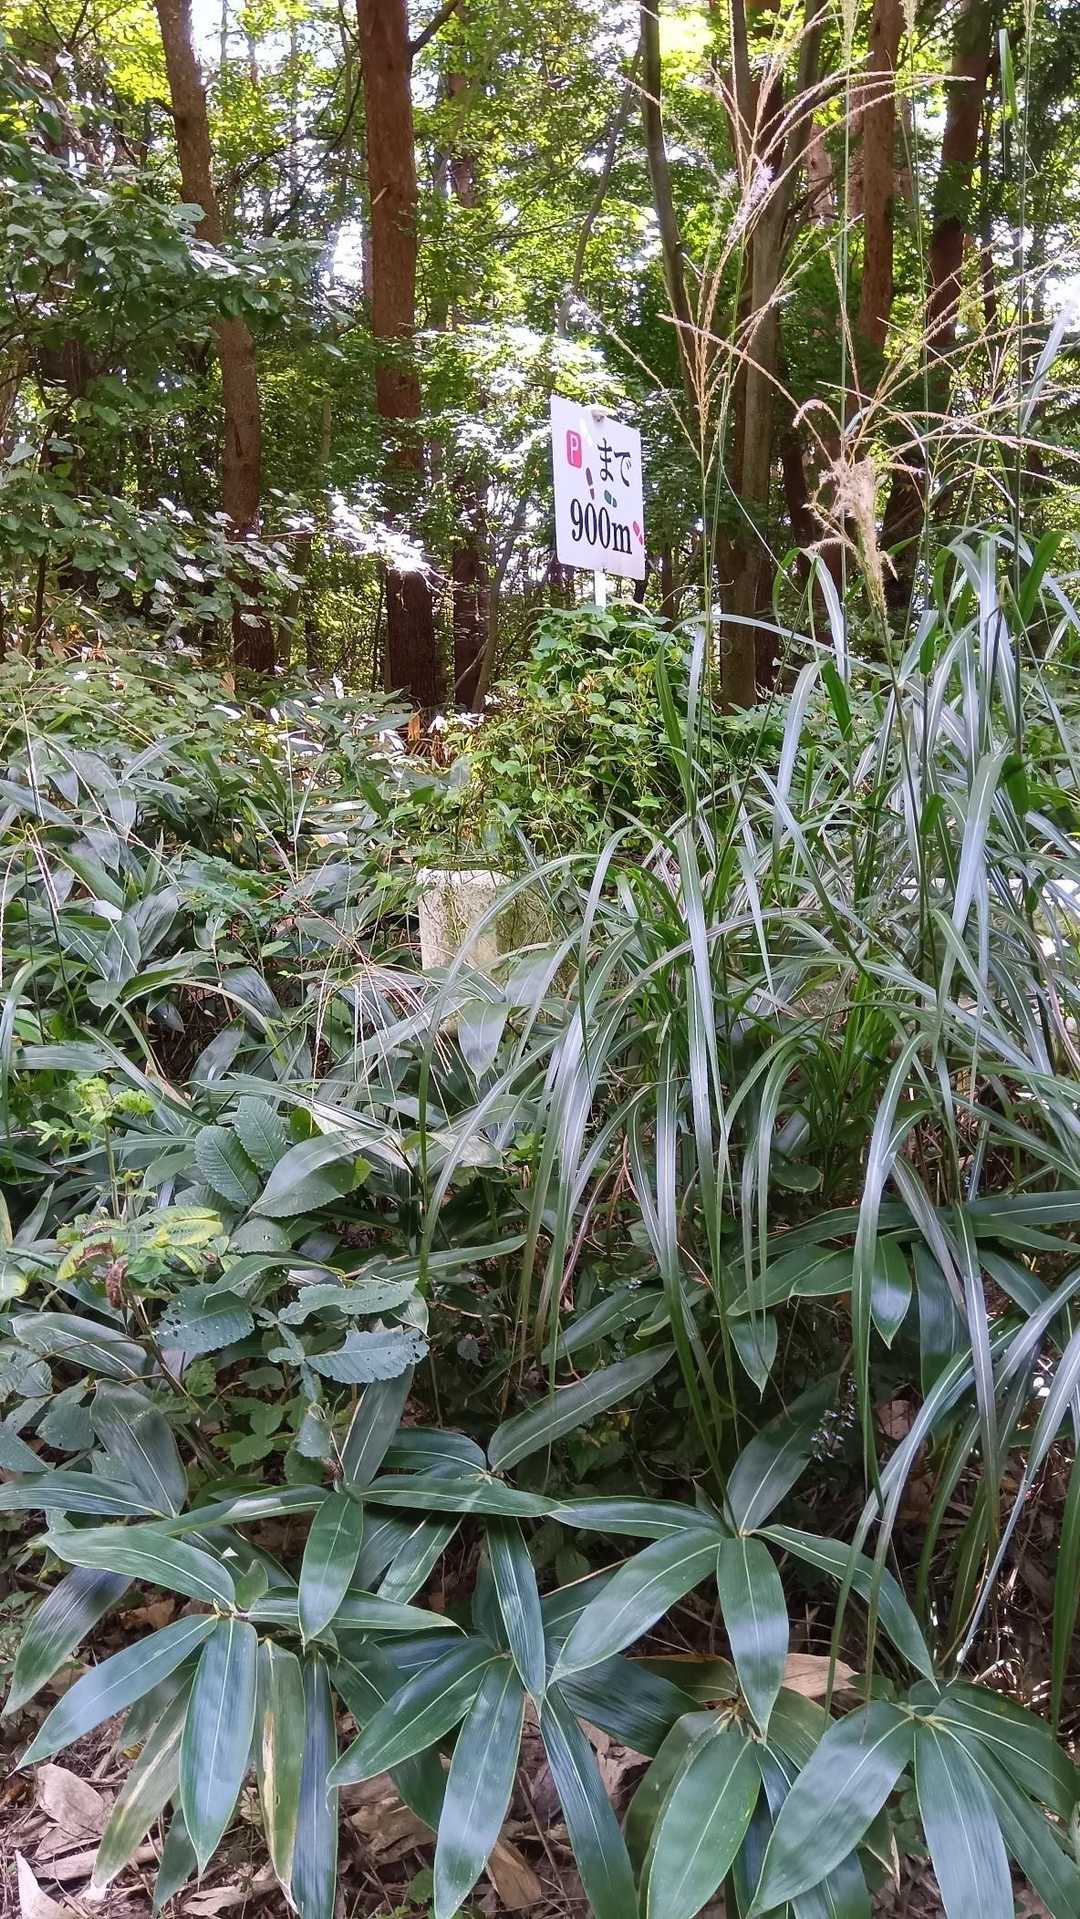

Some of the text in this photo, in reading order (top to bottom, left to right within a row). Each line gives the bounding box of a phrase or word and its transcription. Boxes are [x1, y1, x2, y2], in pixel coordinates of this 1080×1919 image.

[568, 434, 632, 487] P まで
[570, 498, 633, 555] 900m
